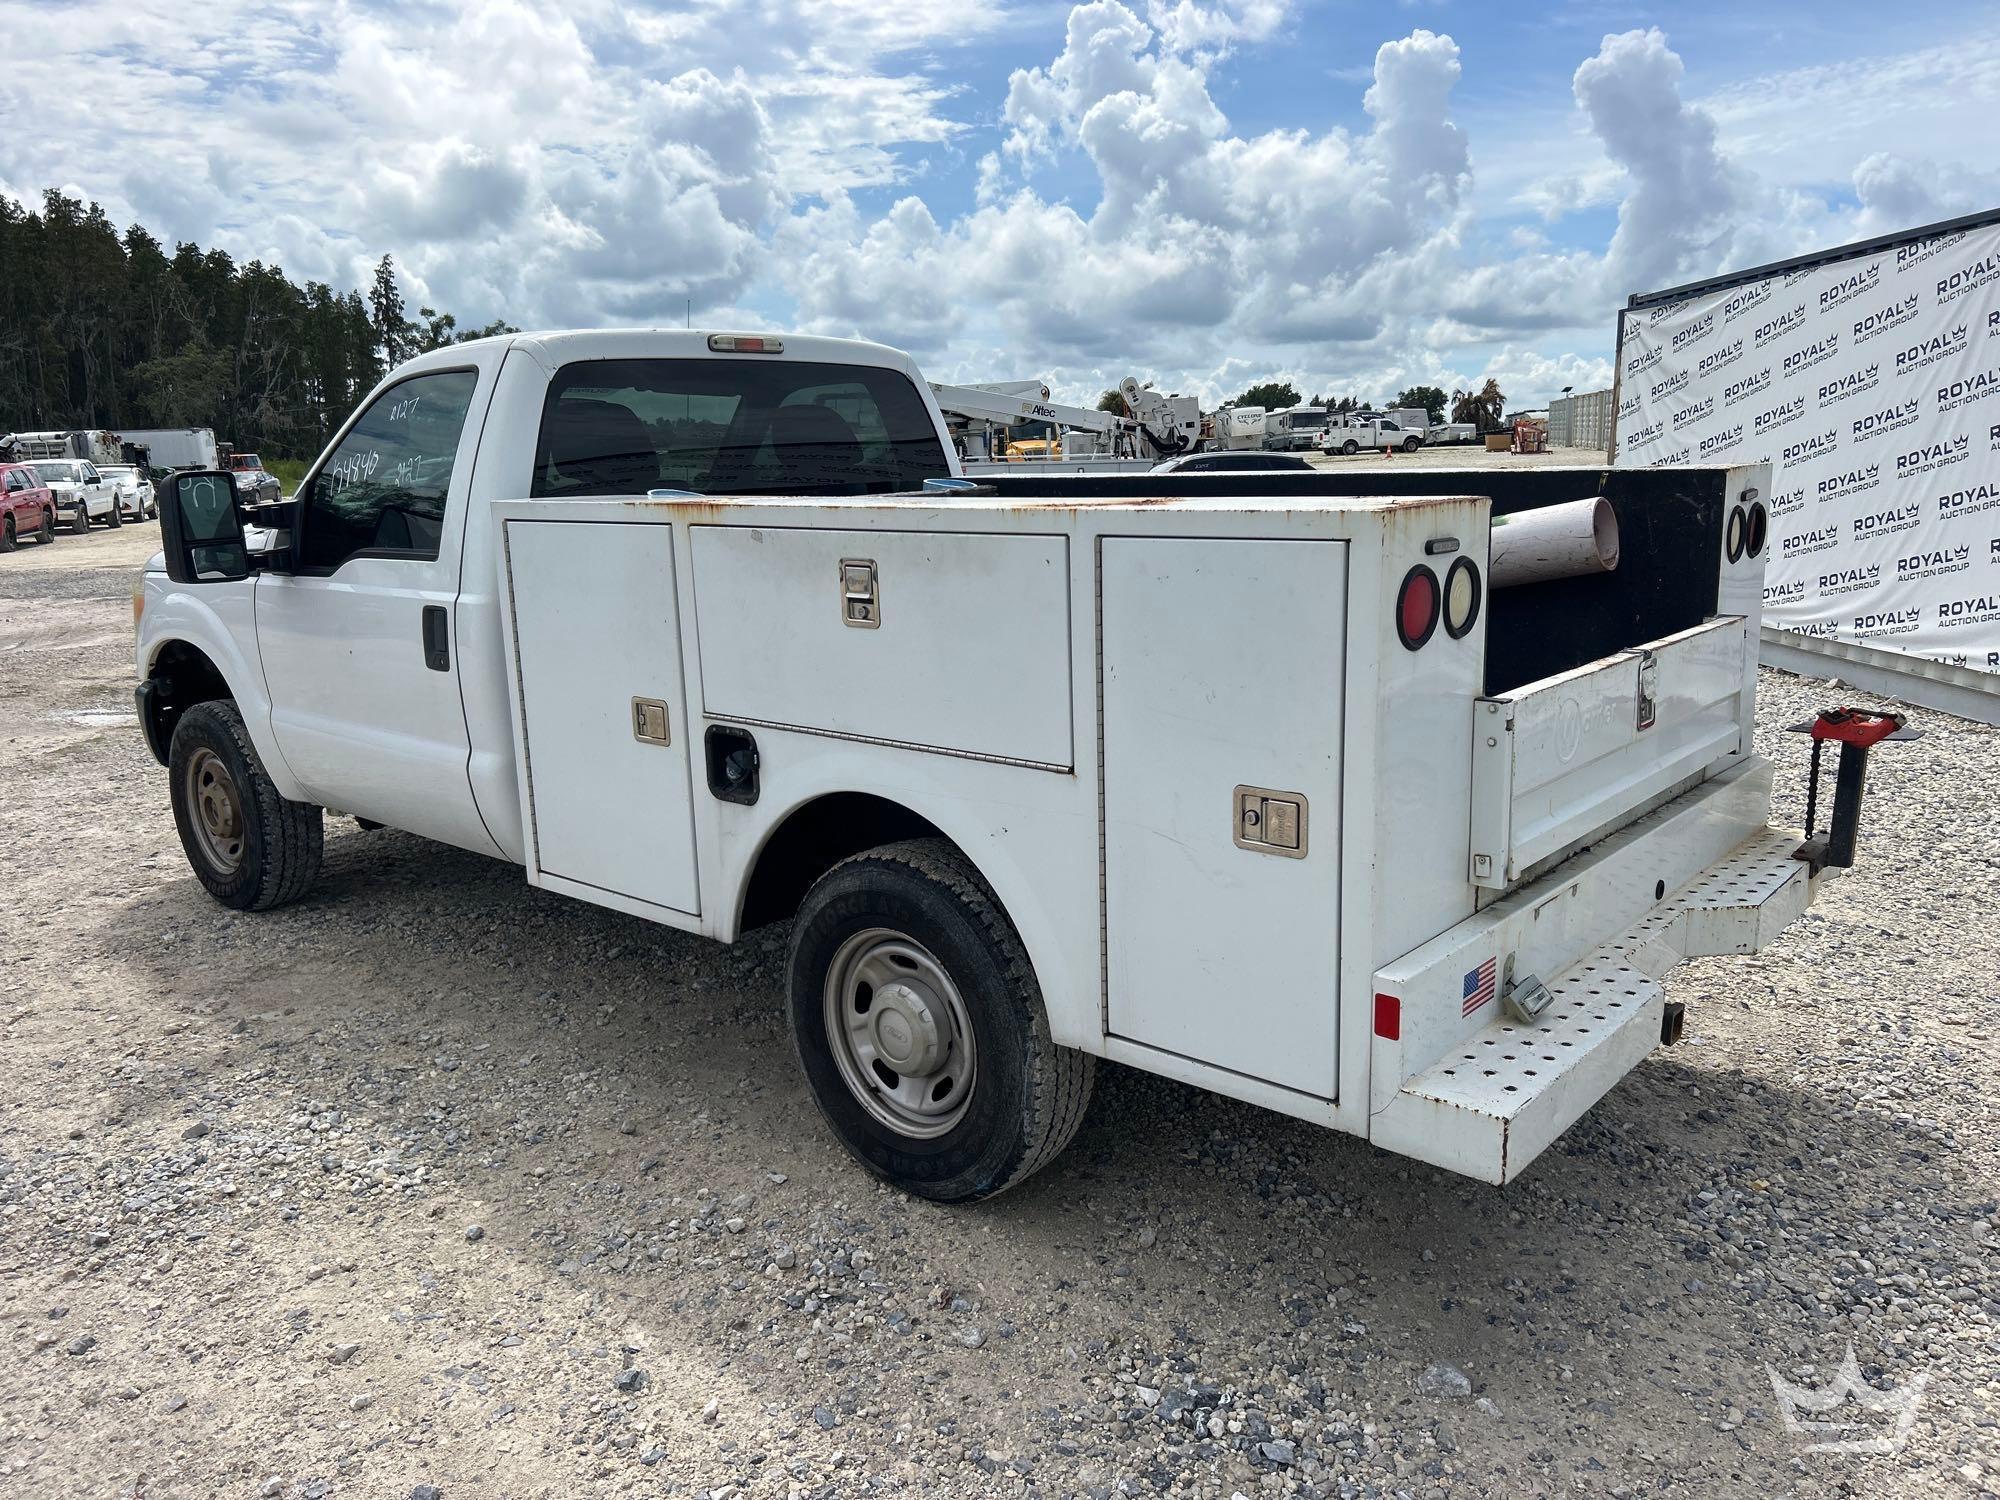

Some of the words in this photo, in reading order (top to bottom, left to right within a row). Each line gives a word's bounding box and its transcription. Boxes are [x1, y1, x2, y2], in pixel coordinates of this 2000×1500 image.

[1898, 249, 1934, 274] AUCTION
[1936, 232, 1966, 254] GROUP
[1937, 258, 1996, 295] ROYAL
[1938, 282, 1978, 306] AUCTION
[1980, 270, 2000, 286] GRO
[1820, 273, 1866, 305] ROYAL
[1820, 293, 1851, 314] AUCTION
[1853, 279, 1880, 298] GROUP
[1724, 288, 1760, 316] ROYAL
[1725, 306, 1750, 323] AUCTION
[1750, 292, 1772, 308] GROUP
[1650, 312, 1672, 328] AUCTION
[1755, 312, 1794, 340] ROYAL
[1854, 304, 1904, 336] ROYAL
[1854, 324, 1888, 346] AUCTION
[1890, 310, 1918, 328] GROUP
[1672, 320, 1704, 346] ROYAL
[1672, 338, 1695, 354] AUCTION
[1696, 327, 1713, 342] GROUP
[1756, 330, 1782, 349] AUCTION
[1783, 318, 1806, 334] GROUP
[1628, 350, 1654, 372] ROYAL
[1699, 345, 1733, 371] ROYAL
[1784, 342, 1826, 370] ROYAL
[1896, 334, 1952, 366] ROYAL
[1897, 355, 1934, 376] AUCTION
[1936, 342, 1968, 360] GROUP
[1700, 362, 1722, 378] AUCTION
[1724, 352, 1743, 366] GROUP
[1784, 359, 1812, 378] AUCTION
[1814, 348, 1838, 364] GROUP
[1652, 374, 1681, 396] ROYAL
[1652, 390, 1672, 404] AUCTION
[1672, 381, 1688, 395] GROUP
[1724, 375, 1760, 399] ROYAL
[1725, 392, 1750, 408] AUCTION
[1750, 381, 1771, 395] GROUP
[1819, 372, 1865, 400] ROYAL
[1819, 390, 1850, 408] AUCTION
[1852, 379, 1879, 395] GROUP
[1938, 370, 1998, 402] ROYAL
[1620, 399, 1635, 412] YAL
[1938, 392, 1980, 413] AUCTION
[1982, 384, 2000, 398] GRO
[1032, 405, 1056, 418] Altec
[1674, 401, 1705, 424] ROYAL
[1674, 418, 1695, 432] AUCTION
[1696, 409, 1714, 422] GROUP
[1755, 403, 1793, 428] ROYAL
[1755, 421, 1781, 436] AUCTION
[1782, 410, 1804, 426] GROUP
[1853, 406, 1904, 434] ROYAL
[1628, 426, 1655, 445] ROYAL
[1700, 430, 1733, 452] ROYAL
[1854, 426, 1888, 444] AUCTION
[1890, 415, 1919, 430] GROUP
[1628, 439, 1648, 452] AUCTION
[1648, 432, 1663, 444] GROUP
[1701, 446, 1723, 460] AUCTION
[1724, 438, 1742, 450] GROUP
[1784, 436, 1824, 460] ROYAL
[1784, 454, 1812, 468] AUCTION
[1813, 444, 1838, 458] GROUP
[1897, 442, 1952, 470] ROYAL
[1898, 462, 1936, 480] AUCTION
[1937, 452, 1969, 468] GROUP
[1818, 470, 1865, 494] ROYAL
[1818, 488, 1850, 503] AUCTION
[1852, 480, 1880, 493] GROUP
[1771, 494, 1793, 508] YAL
[1782, 503, 1804, 514] GROUP
[1940, 484, 1999, 510] ROYAL
[1854, 508, 1905, 532] ROYAL
[1940, 504, 1981, 520] AUCTION
[1982, 499, 2000, 510] GRO
[1784, 530, 1825, 550] ROYAL
[1854, 527, 1890, 542] AUCTION
[1891, 520, 1920, 533] GROUP
[1784, 546, 1812, 559] AUCTION
[1814, 540, 1838, 552] GROUP
[1898, 550, 1953, 572] ROYAL
[1820, 568, 1866, 588] ROYAL
[1898, 568, 1936, 582] AUCTION
[1938, 562, 1970, 574] GROUP
[1763, 584, 1793, 600] OYAL
[1781, 594, 1804, 604] GROUP
[1820, 585, 1852, 597] AUCTION
[1853, 580, 1880, 590] GROUP
[1939, 597, 1998, 618] ROYAL
[1854, 612, 1905, 629] ROYAL
[1854, 628, 1888, 638] AUCTION
[1890, 624, 1920, 634] GROUP
[1938, 616, 1979, 628] AUCTION
[1981, 613, 2000, 622] GRO
